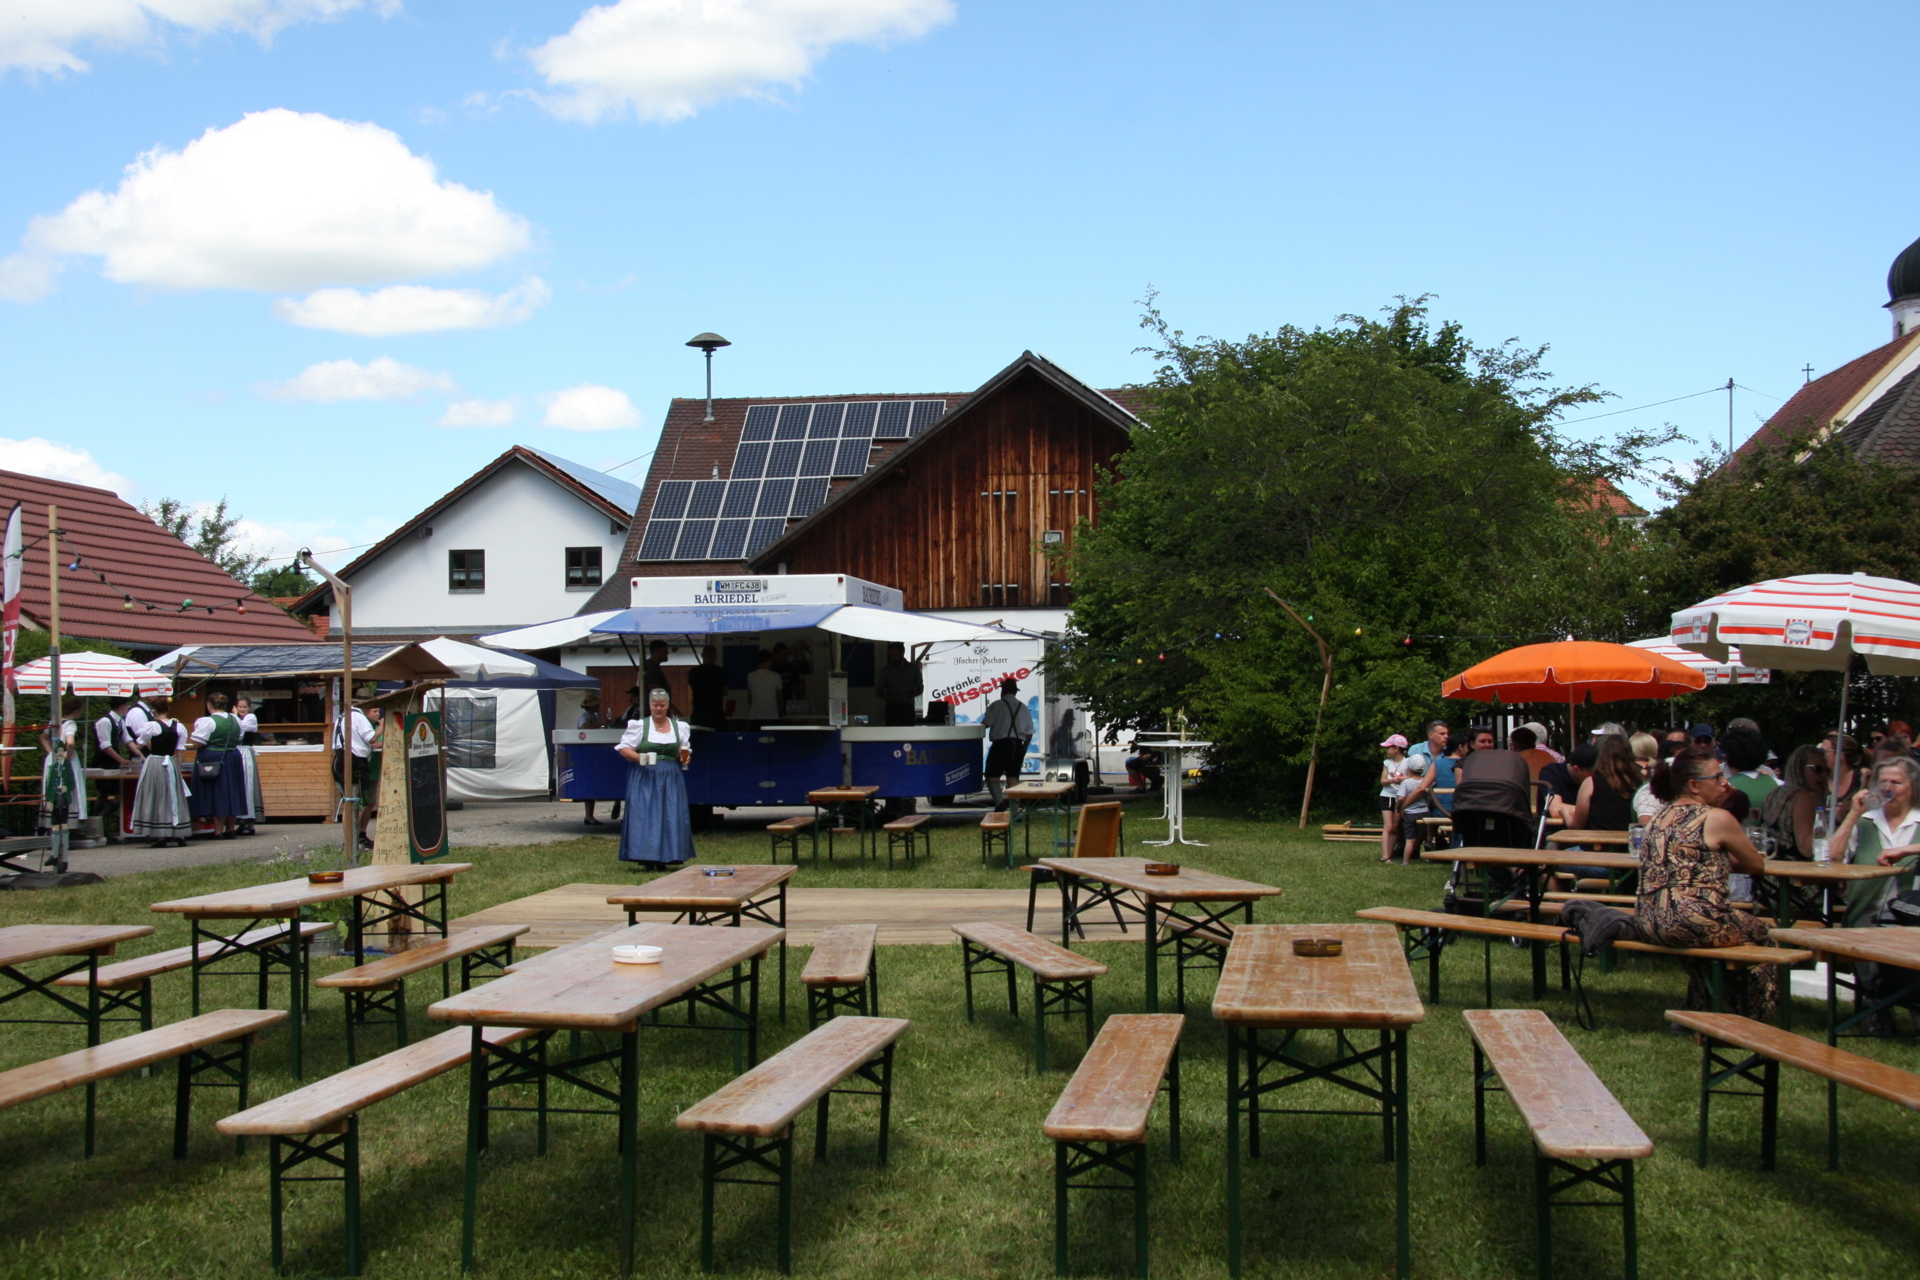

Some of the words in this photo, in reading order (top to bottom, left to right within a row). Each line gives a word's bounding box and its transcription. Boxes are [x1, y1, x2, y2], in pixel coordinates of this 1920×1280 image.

[745, 581, 760, 589] 438
[694, 594, 758, 604] BAURIEDEL
[932, 675, 981, 699] Getränke
